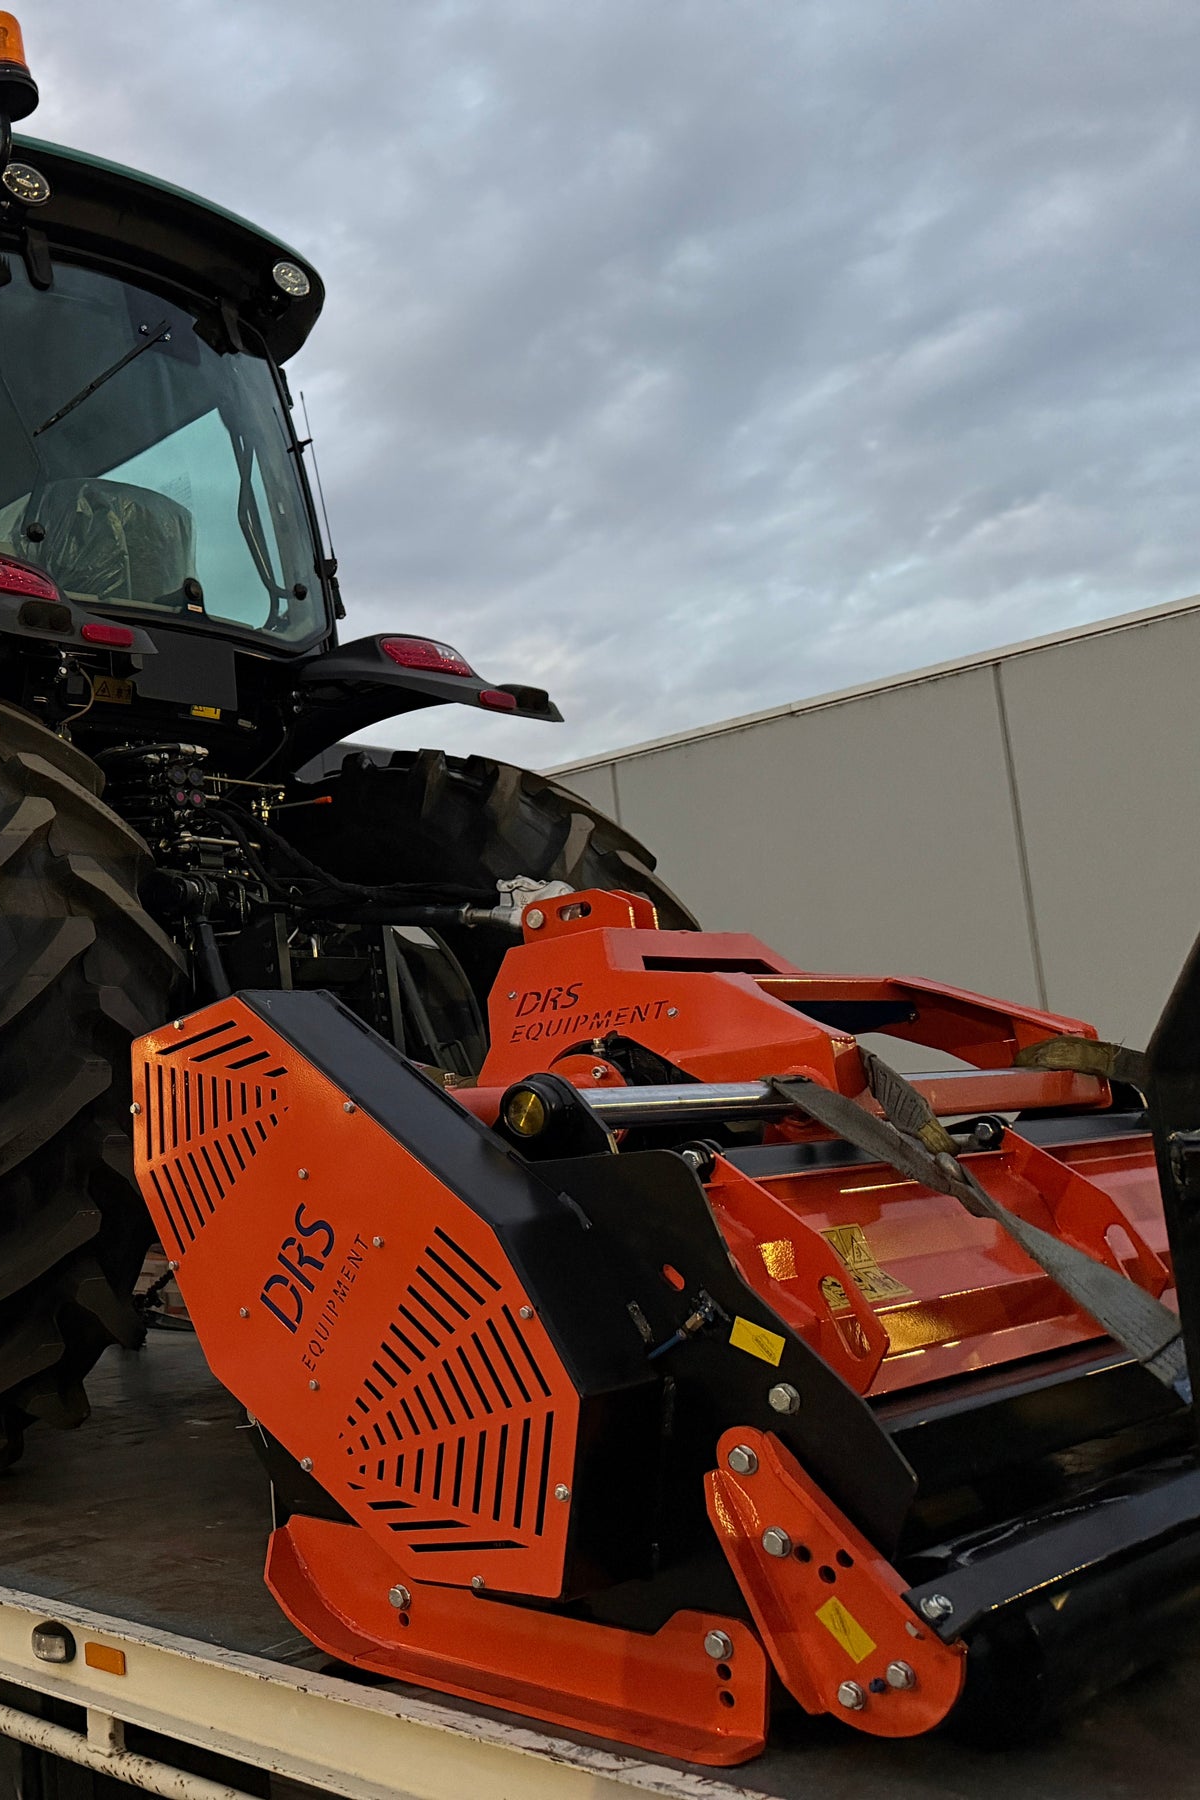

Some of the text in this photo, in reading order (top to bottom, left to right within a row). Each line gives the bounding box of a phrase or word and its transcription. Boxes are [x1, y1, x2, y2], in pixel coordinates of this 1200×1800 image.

[509, 1000, 669, 1043] EQUIPMENT
[515, 982, 583, 1017] DRS
[260, 1203, 335, 1334] DRS
[301, 1234, 368, 1372] EQUIPMENT
